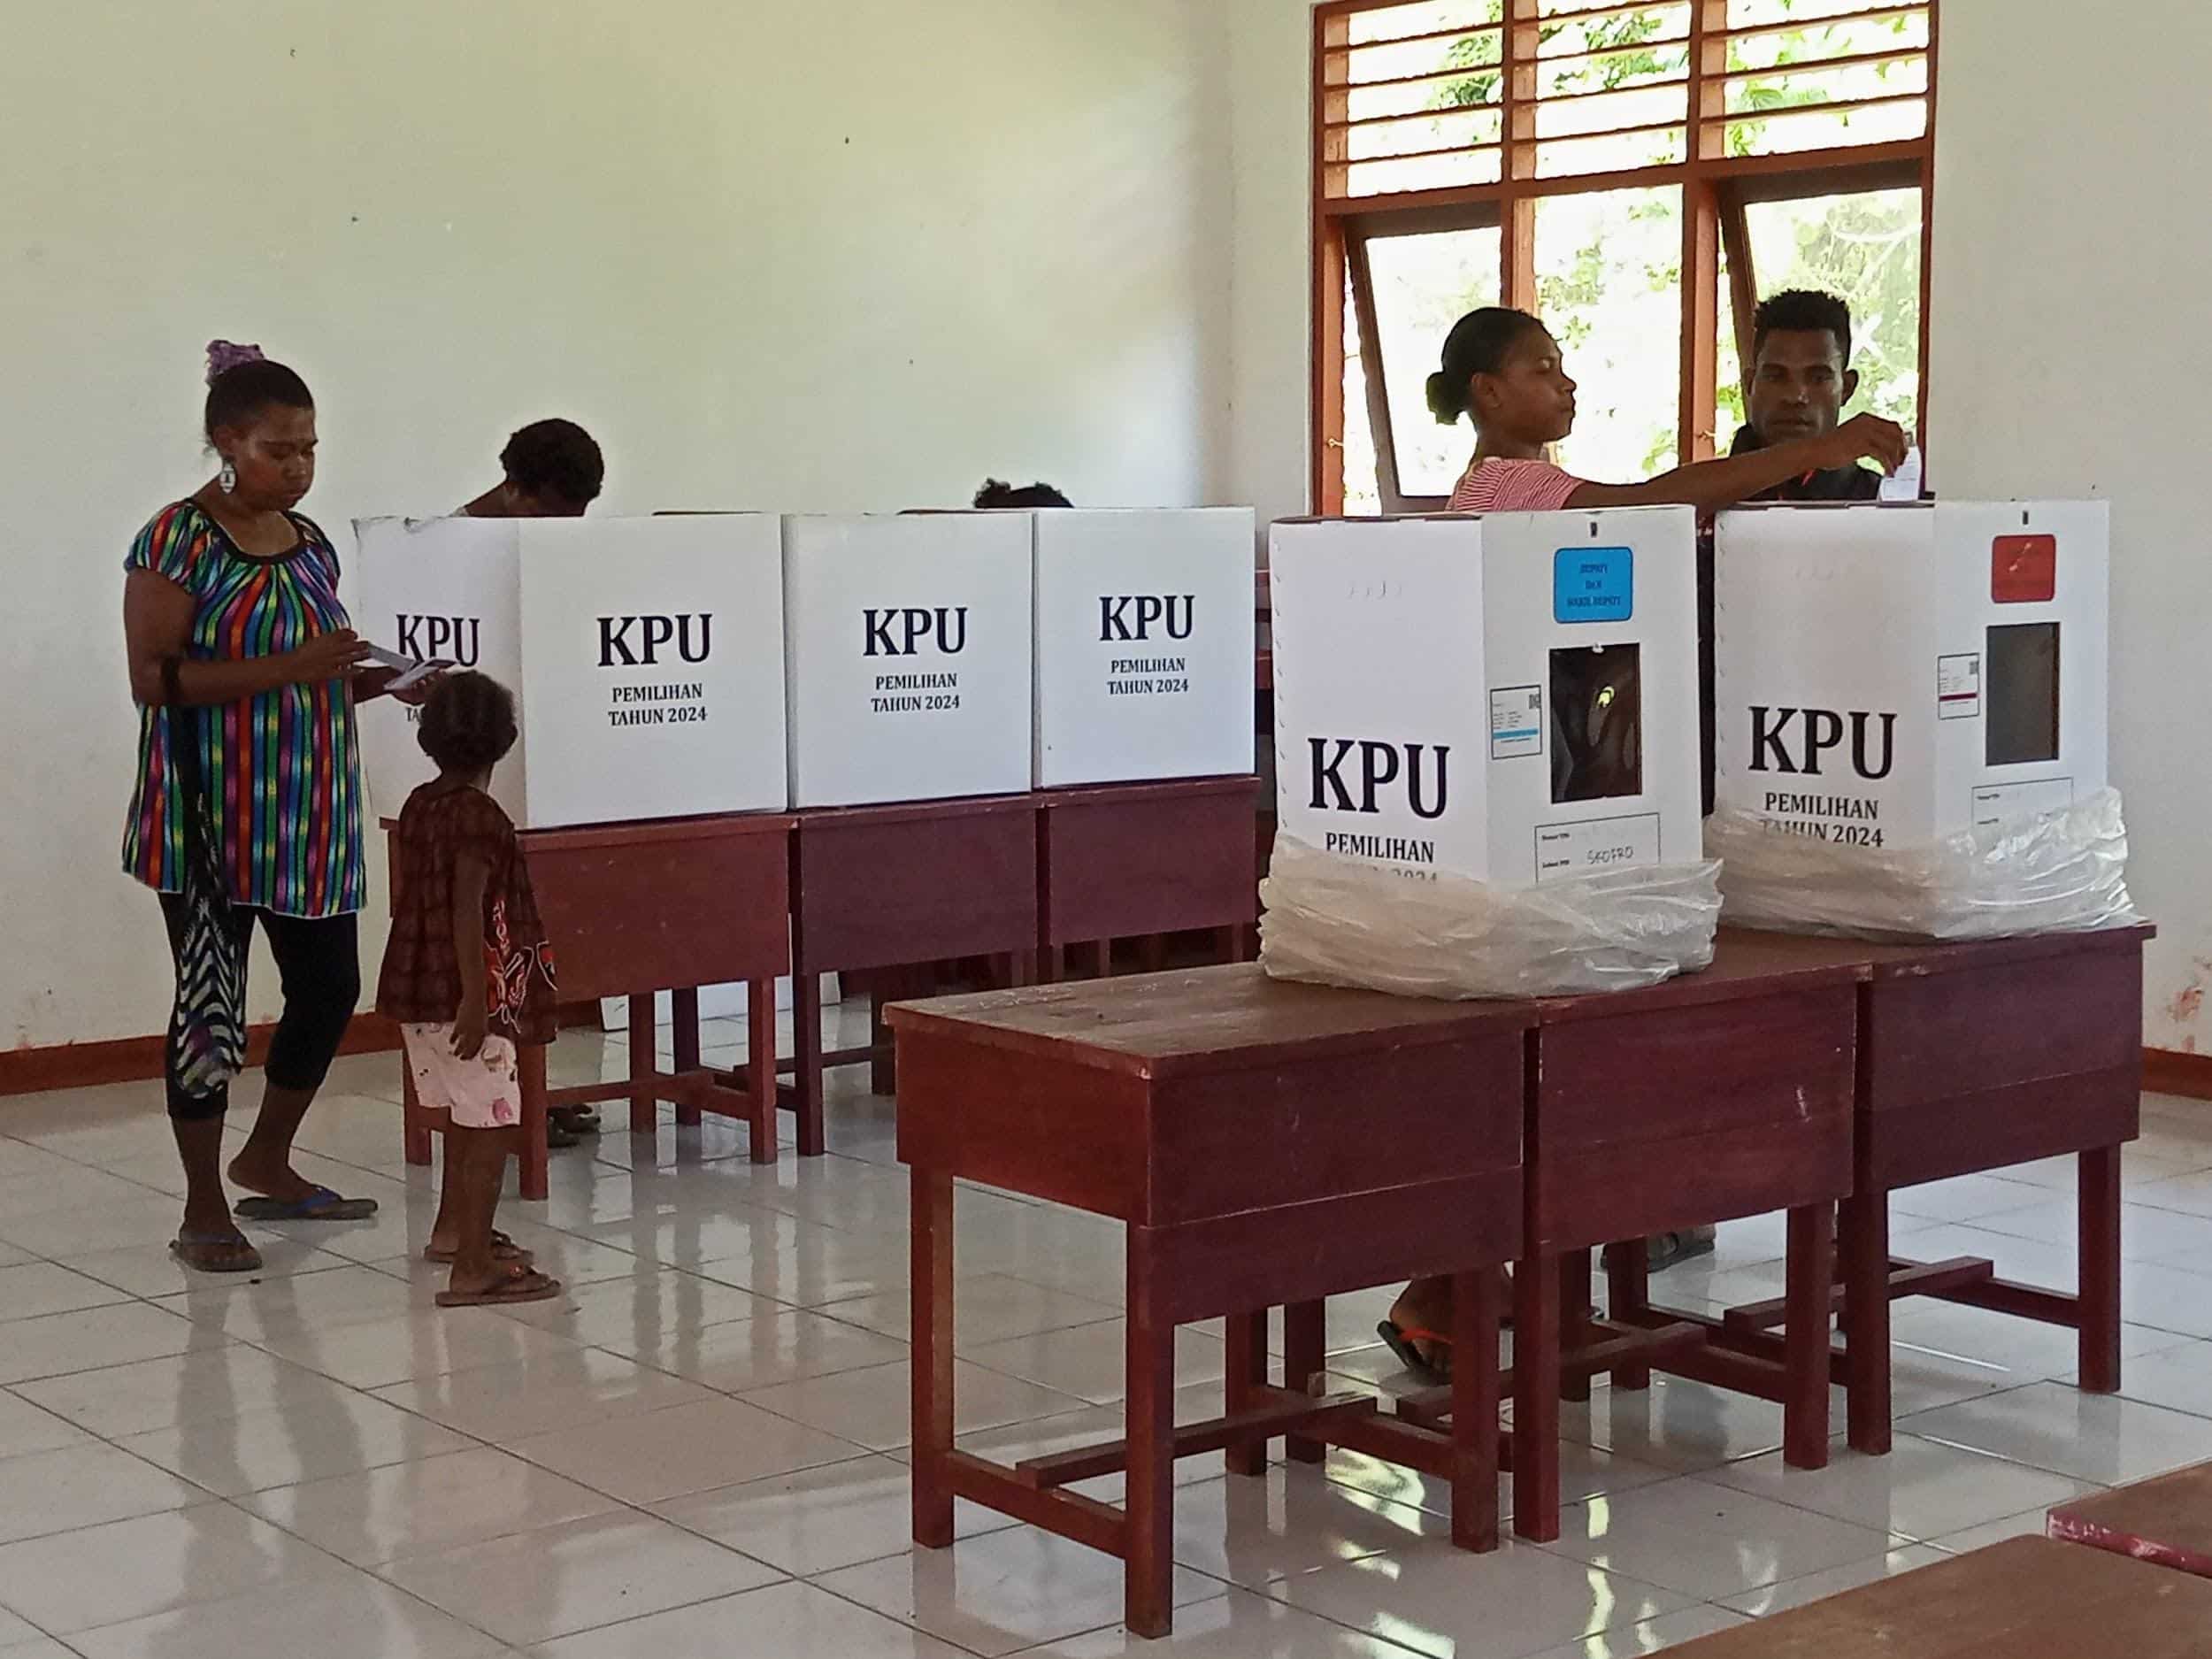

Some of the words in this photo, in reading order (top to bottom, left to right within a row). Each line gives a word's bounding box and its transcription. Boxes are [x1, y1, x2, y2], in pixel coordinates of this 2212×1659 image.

[863, 607, 968, 656] KPU
[1099, 595, 1195, 641] KPU
[396, 614, 480, 670] KPU
[596, 613, 713, 667] KPU
[1110, 657, 1186, 673] PEMILIHAN
[612, 683, 703, 703] PEMILIHAN
[875, 672, 957, 690] PEMILIHAN
[1107, 680, 1153, 695] TAHUN
[1156, 679, 1188, 693] 2024
[608, 708, 664, 726] TAHUN
[667, 706, 707, 723] 2024
[871, 695, 922, 712] TAHUN
[926, 695, 960, 710] 2024
[1748, 705, 1898, 780] KPU
[1307, 737, 1450, 818] KPU
[1764, 792, 1879, 819] PEMILIHAN
[1325, 832, 1434, 864] PEMILIHAN
[1832, 824, 1884, 847] 2024
